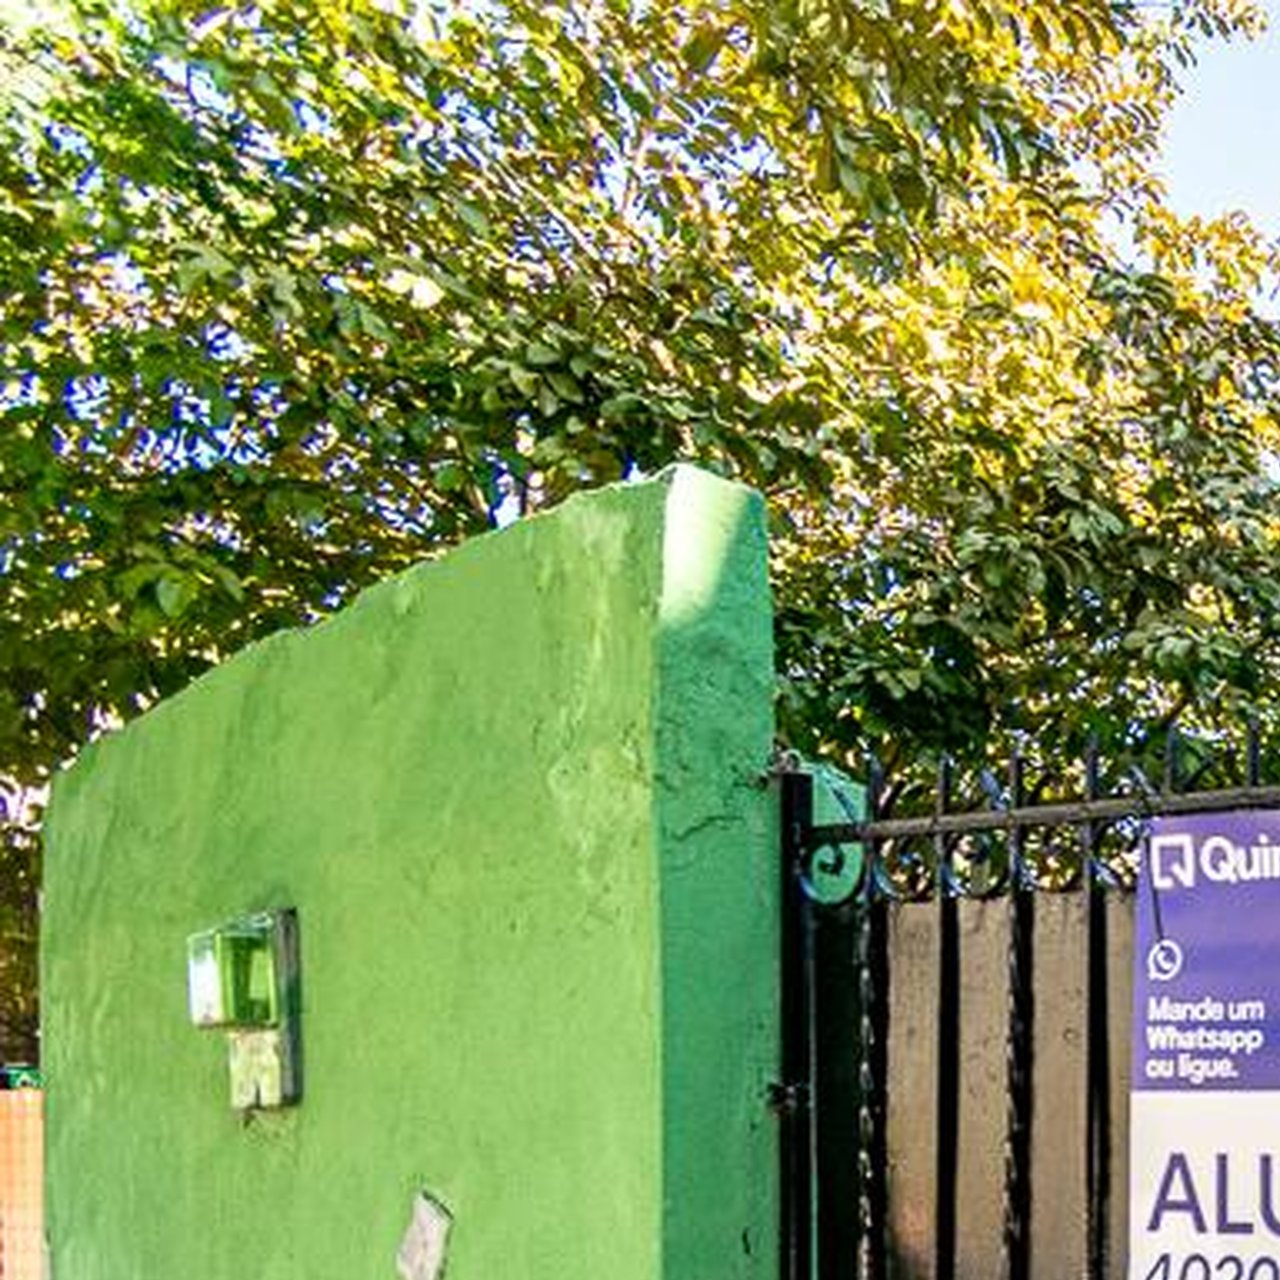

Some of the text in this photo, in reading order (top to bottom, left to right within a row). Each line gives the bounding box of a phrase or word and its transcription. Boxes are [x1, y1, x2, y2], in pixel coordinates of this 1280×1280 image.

[1147, 996, 1265, 1021] Mande um
[1146, 1052, 1239, 1084] ou ligue.
